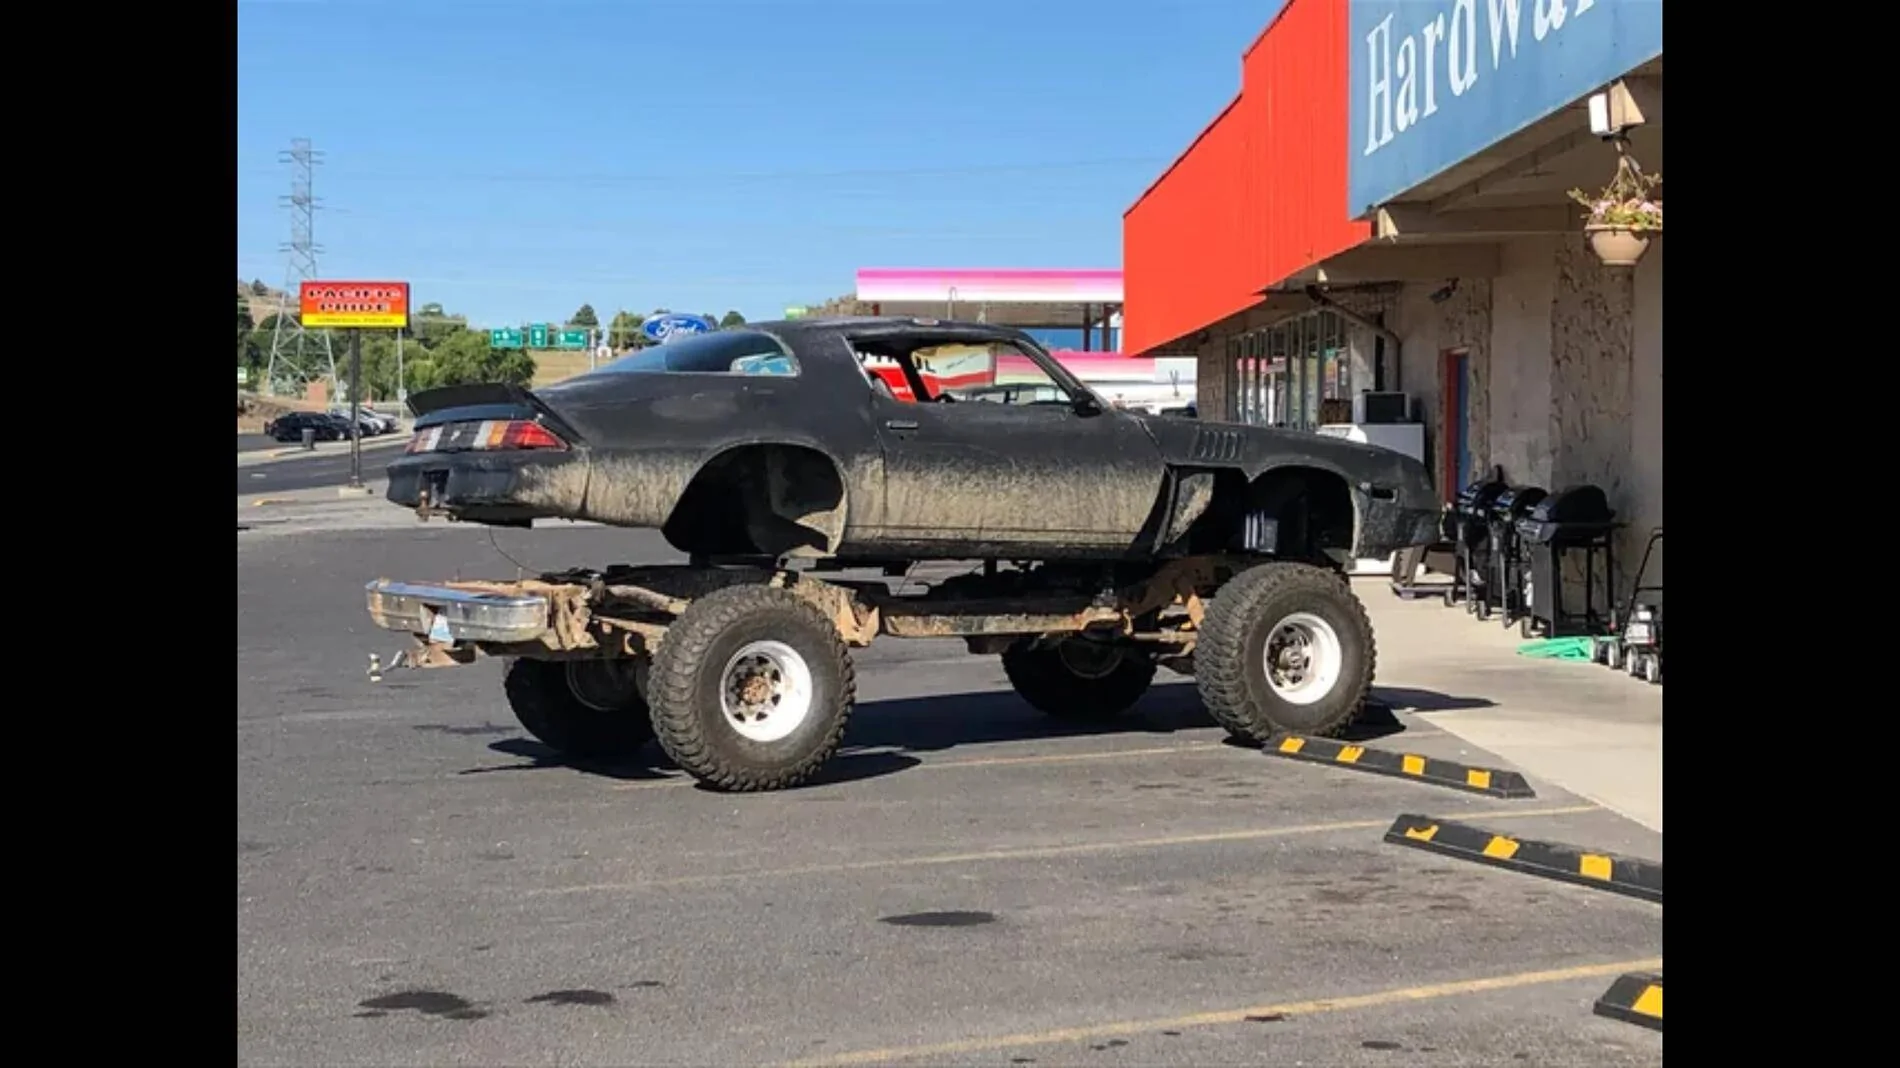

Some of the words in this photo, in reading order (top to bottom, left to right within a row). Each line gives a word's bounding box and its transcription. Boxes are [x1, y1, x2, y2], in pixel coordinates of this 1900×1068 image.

[1364, 0, 1595, 156] Hardw
[307, 287, 401, 299] PACIFIC
[319, 301, 390, 312] PRIDE
[655, 319, 700, 341] Ford
